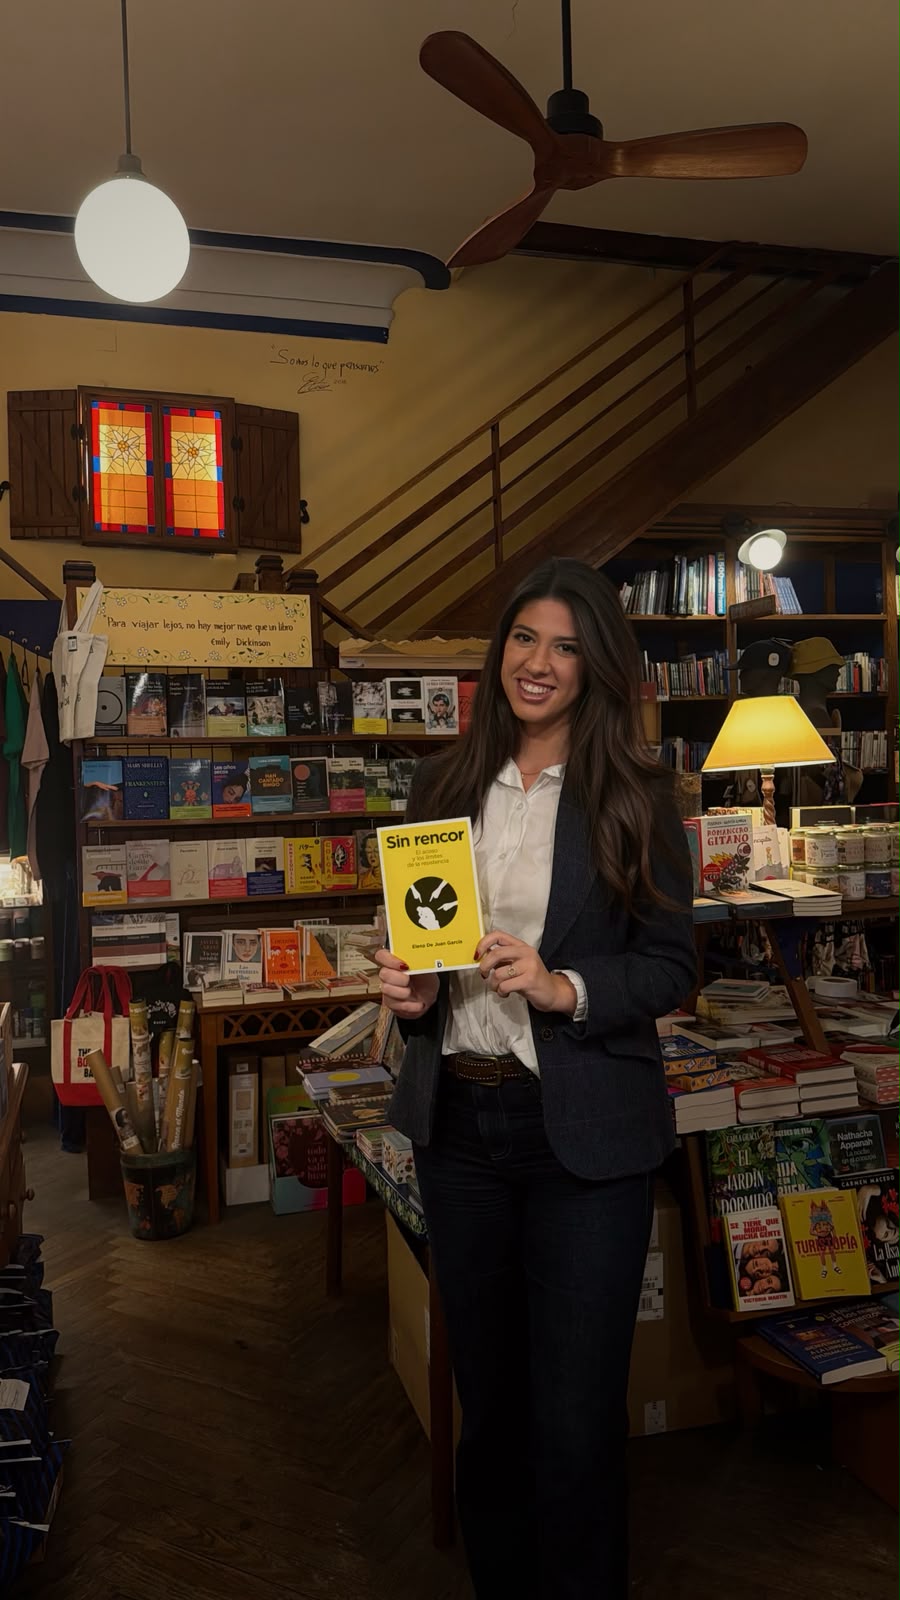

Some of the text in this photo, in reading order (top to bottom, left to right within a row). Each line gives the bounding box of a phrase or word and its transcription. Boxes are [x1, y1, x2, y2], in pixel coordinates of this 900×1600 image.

[312, 354, 320, 368] lo
[322, 362, 337, 379] que
[107, 617, 294, 635] Para viajar lejos, no hay mejor nave que un libro
[211, 636, 271, 649] Emily Dickinson
[707, 827, 749, 836] ROMANCERO
[386, 830, 465, 849] Sin rencor
[707, 834, 749, 846] GITANO
[77, 1057, 91, 1068] BO
[837, 1130, 873, 1141] Nathacha
[840, 1139, 873, 1150] Appanah
[738, 1149, 751, 1166] EL
[854, 1148, 870, 1156] noche
[727, 1168, 765, 1190] JARDÍN
[841, 1175, 895, 1187] CARMEN MACEDO
[721, 1191, 774, 1216] DORMIDO
[743, 1219, 762, 1228] TIENE
[765, 1217, 779, 1226] QUE
[732, 1229, 781, 1242] MUCHA GENTE
[795, 1232, 858, 1254] TURISTOPÍA
[873, 1243, 885, 1261] La
